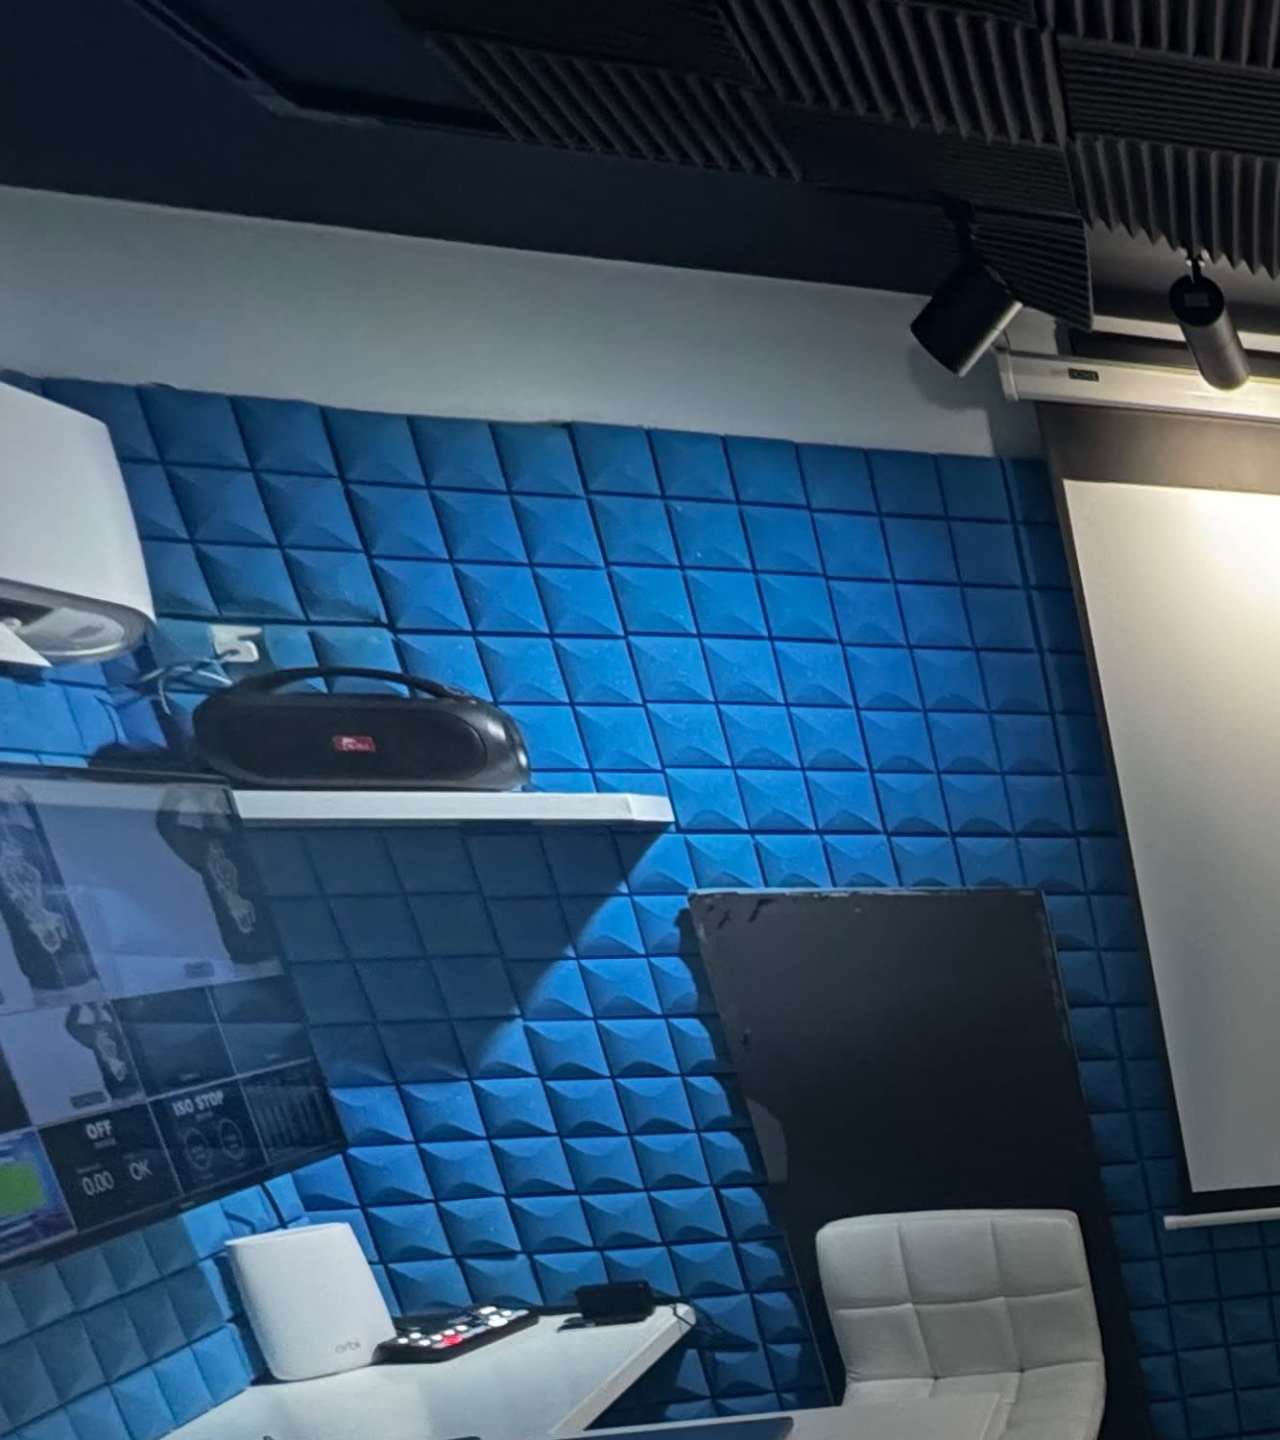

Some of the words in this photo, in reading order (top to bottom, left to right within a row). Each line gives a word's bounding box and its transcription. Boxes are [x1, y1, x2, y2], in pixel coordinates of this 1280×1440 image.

[195, 1090, 224, 1110] STOP
[85, 1119, 113, 1140] OFF
[129, 1159, 153, 1181] OK
